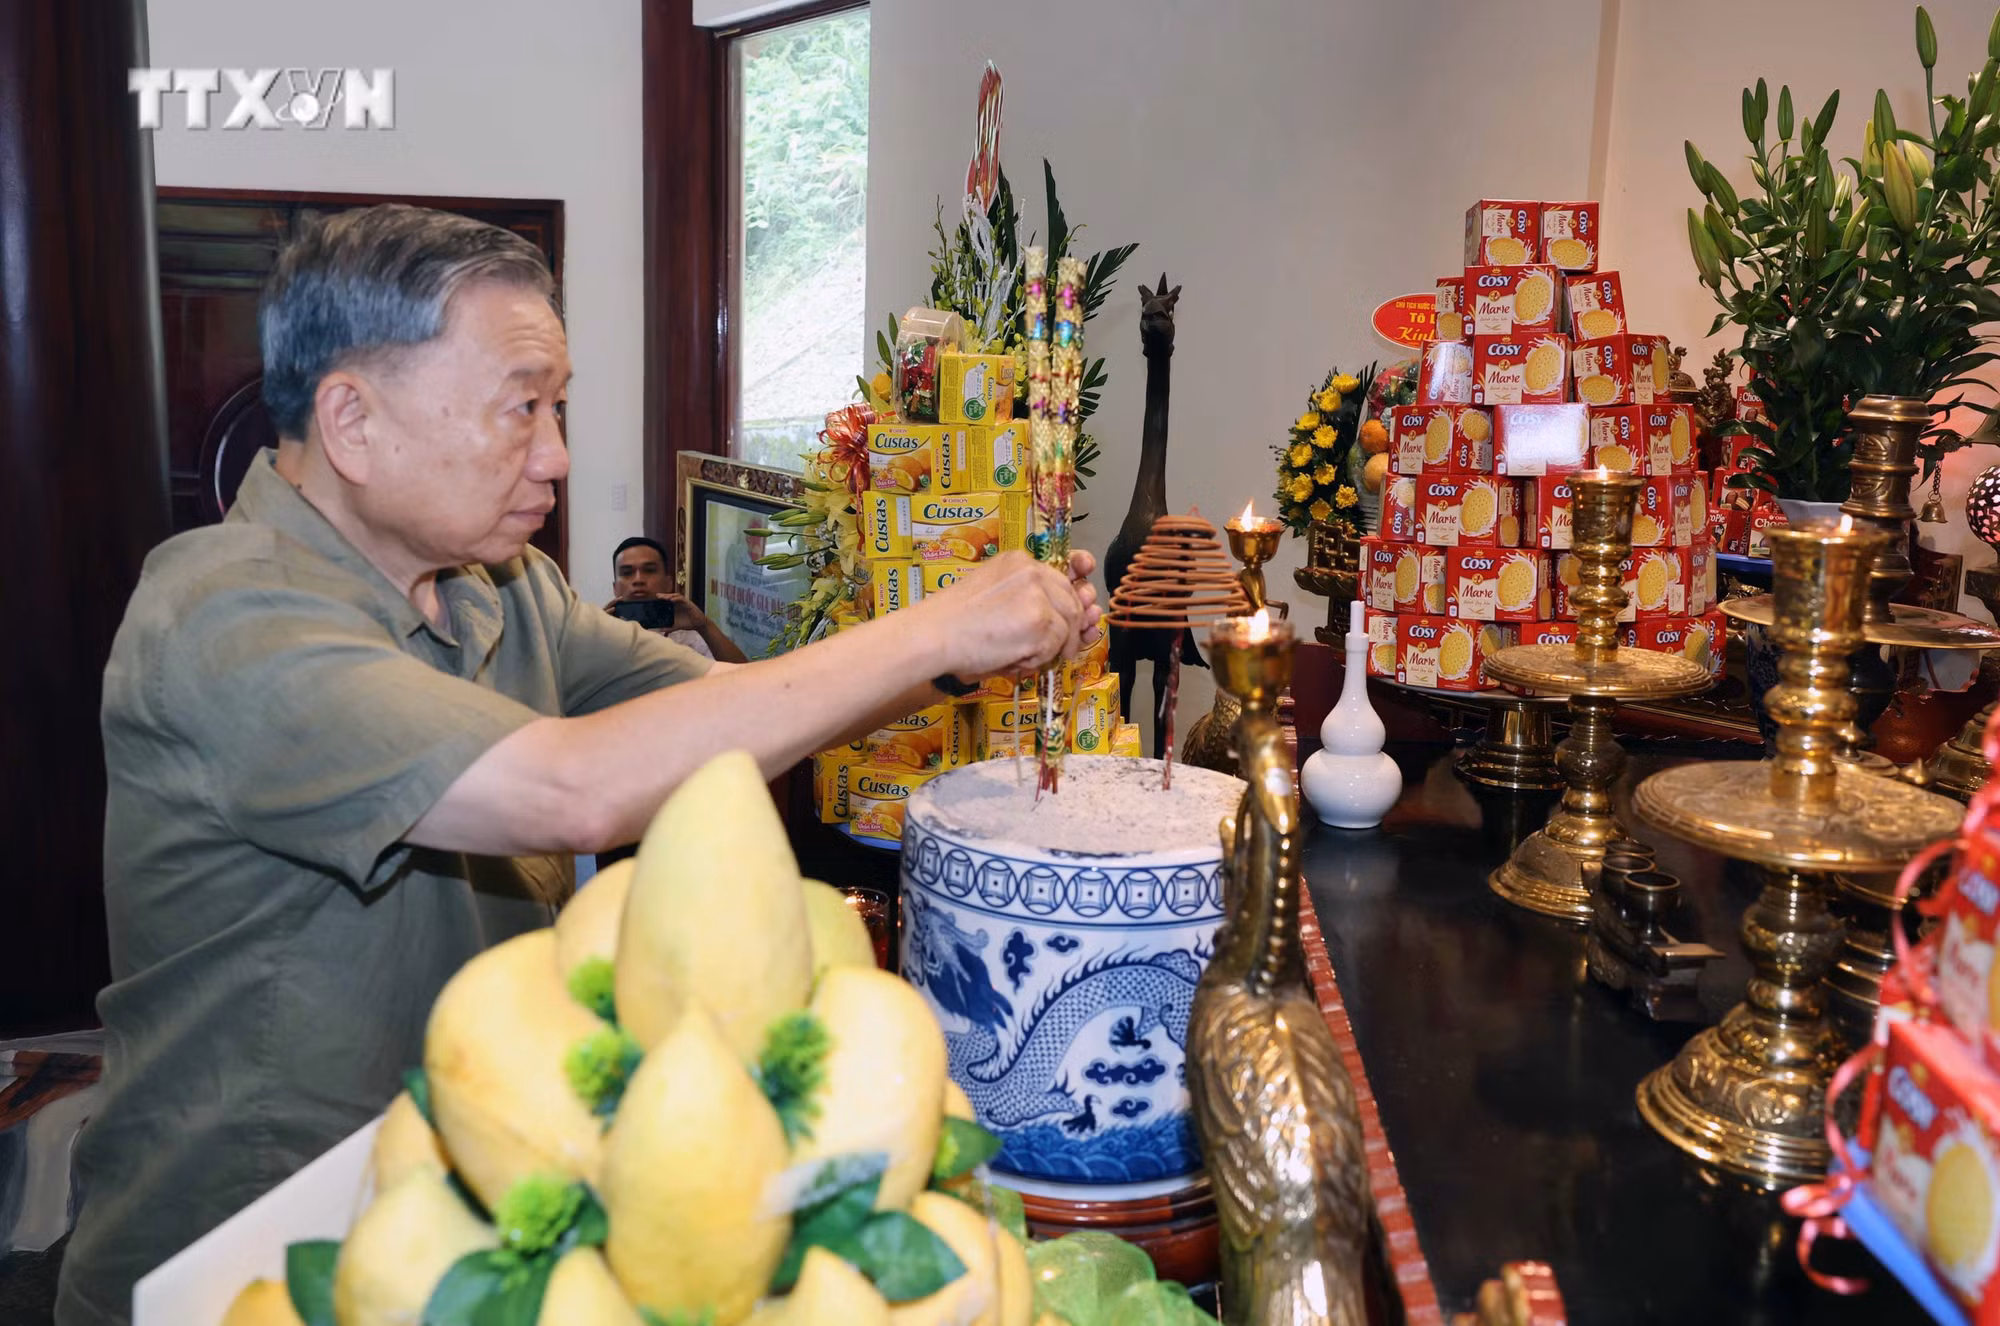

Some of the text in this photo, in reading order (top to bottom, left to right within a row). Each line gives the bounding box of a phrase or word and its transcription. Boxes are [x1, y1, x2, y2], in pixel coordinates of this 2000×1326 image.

[1497, 212, 1506, 234] Marie
[1517, 210, 1527, 234] COSY
[1558, 213, 1567, 235] Marie
[1579, 210, 1589, 235] COSY
[1478, 275, 1511, 287] COSY
[1583, 286, 1592, 308] Marie
[1602, 281, 1612, 304] COSY
[1479, 302, 1510, 315] Marie
[1410, 313, 1426, 324] TÔ
[1488, 343, 1521, 355] COSY
[1632, 344, 1648, 355] COSY
[1604, 345, 1613, 369] COSY
[1488, 371, 1520, 384] Marie
[1402, 414, 1424, 427] COSY
[1650, 414, 1668, 426] COSY
[1620, 416, 1630, 440] COSY
[875, 433, 919, 449] Custas
[1401, 441, 1422, 453] Marie
[941, 433, 951, 489] Custas
[1460, 443, 1468, 467] COSY
[1428, 484, 1458, 496] COSY
[1554, 485, 1572, 498] CO
[1675, 485, 1688, 496] COSY
[1647, 487, 1656, 510] COSY
[924, 503, 984, 519] Custas
[1428, 511, 1457, 524] Marie
[875, 498, 889, 553] Custas
[1393, 511, 1402, 534] COSY
[1374, 550, 1394, 563] COSY
[1462, 556, 1494, 569] COSY
[1374, 576, 1393, 590] Marie
[887, 568, 899, 614] ustas
[1462, 585, 1493, 598] Marie
[1409, 625, 1437, 638] COSY
[1656, 631, 1681, 644] COSY
[1537, 634, 1570, 644] COSY
[1408, 653, 1435, 666] Marie
[950, 711, 959, 766] Custas
[833, 765, 848, 818] Custas
[858, 777, 910, 797] Custas
